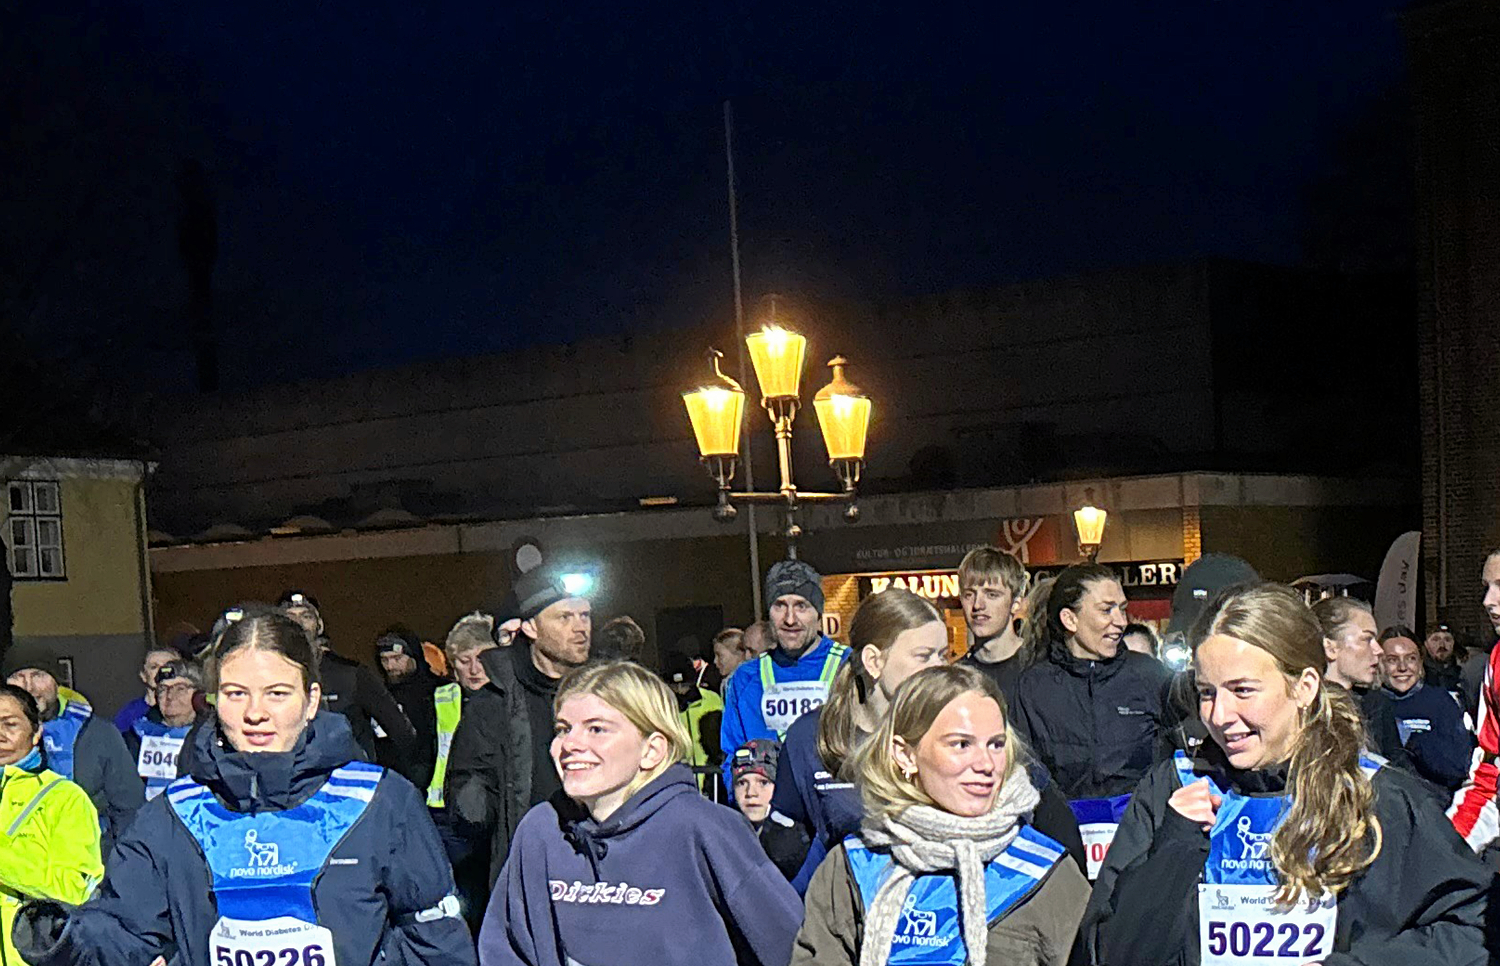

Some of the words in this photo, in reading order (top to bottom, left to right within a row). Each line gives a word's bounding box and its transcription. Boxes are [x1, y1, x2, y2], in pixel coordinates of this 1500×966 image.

[1221, 859, 1247, 869] novo
[230, 867, 256, 879] novo
[257, 864, 296, 877] nordisk
[549, 880, 666, 905] Dickies
[1240, 896, 1267, 905] World
[239, 929, 264, 937] World
[265, 926, 302, 937] Diabetes
[892, 934, 910, 944] ovo
[912, 934, 949, 947] nordisk
[1208, 921, 1325, 957] 50222
